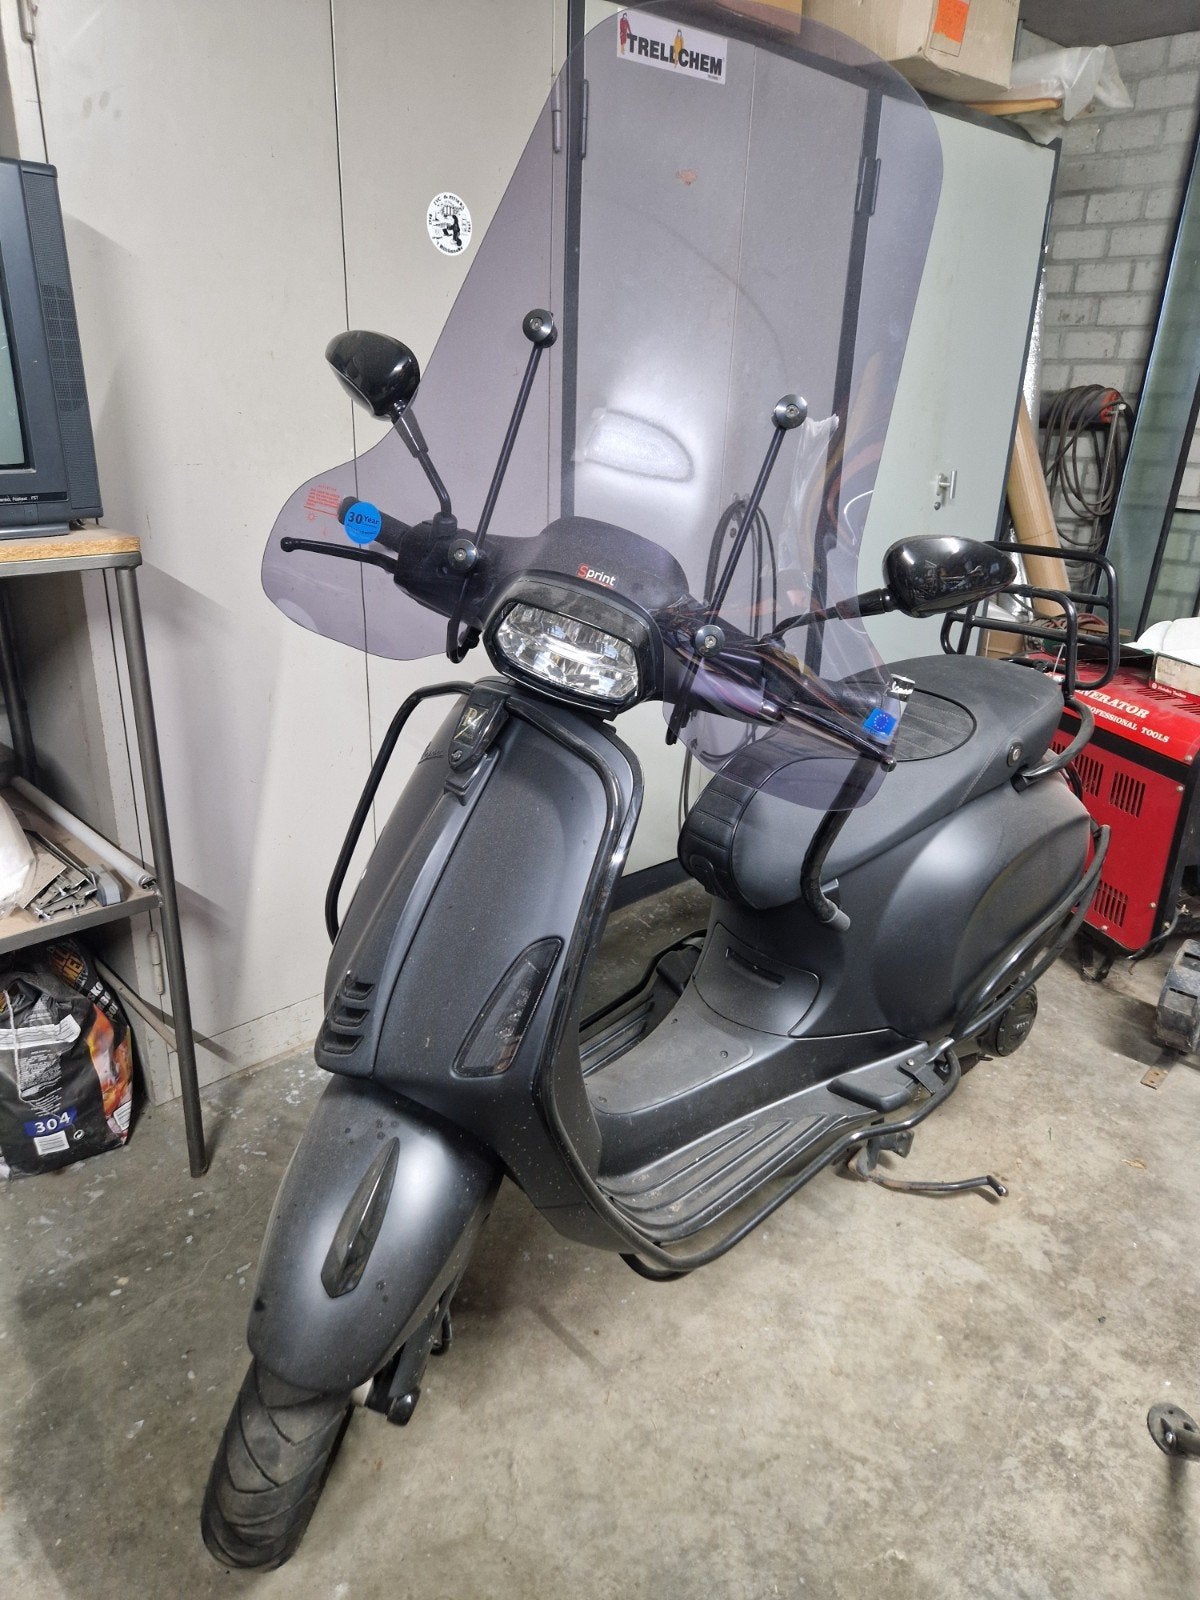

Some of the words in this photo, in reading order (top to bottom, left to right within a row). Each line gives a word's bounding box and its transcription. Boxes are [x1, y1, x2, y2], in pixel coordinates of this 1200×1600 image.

[348, 512, 362, 524] 30
[364, 516, 380, 525] Year
[577, 565, 616, 586] Sprint
[1087, 705, 1137, 731] OFESSIONAL
[1141, 726, 1170, 743] TOOLS
[35, 1112, 71, 1133] 304
